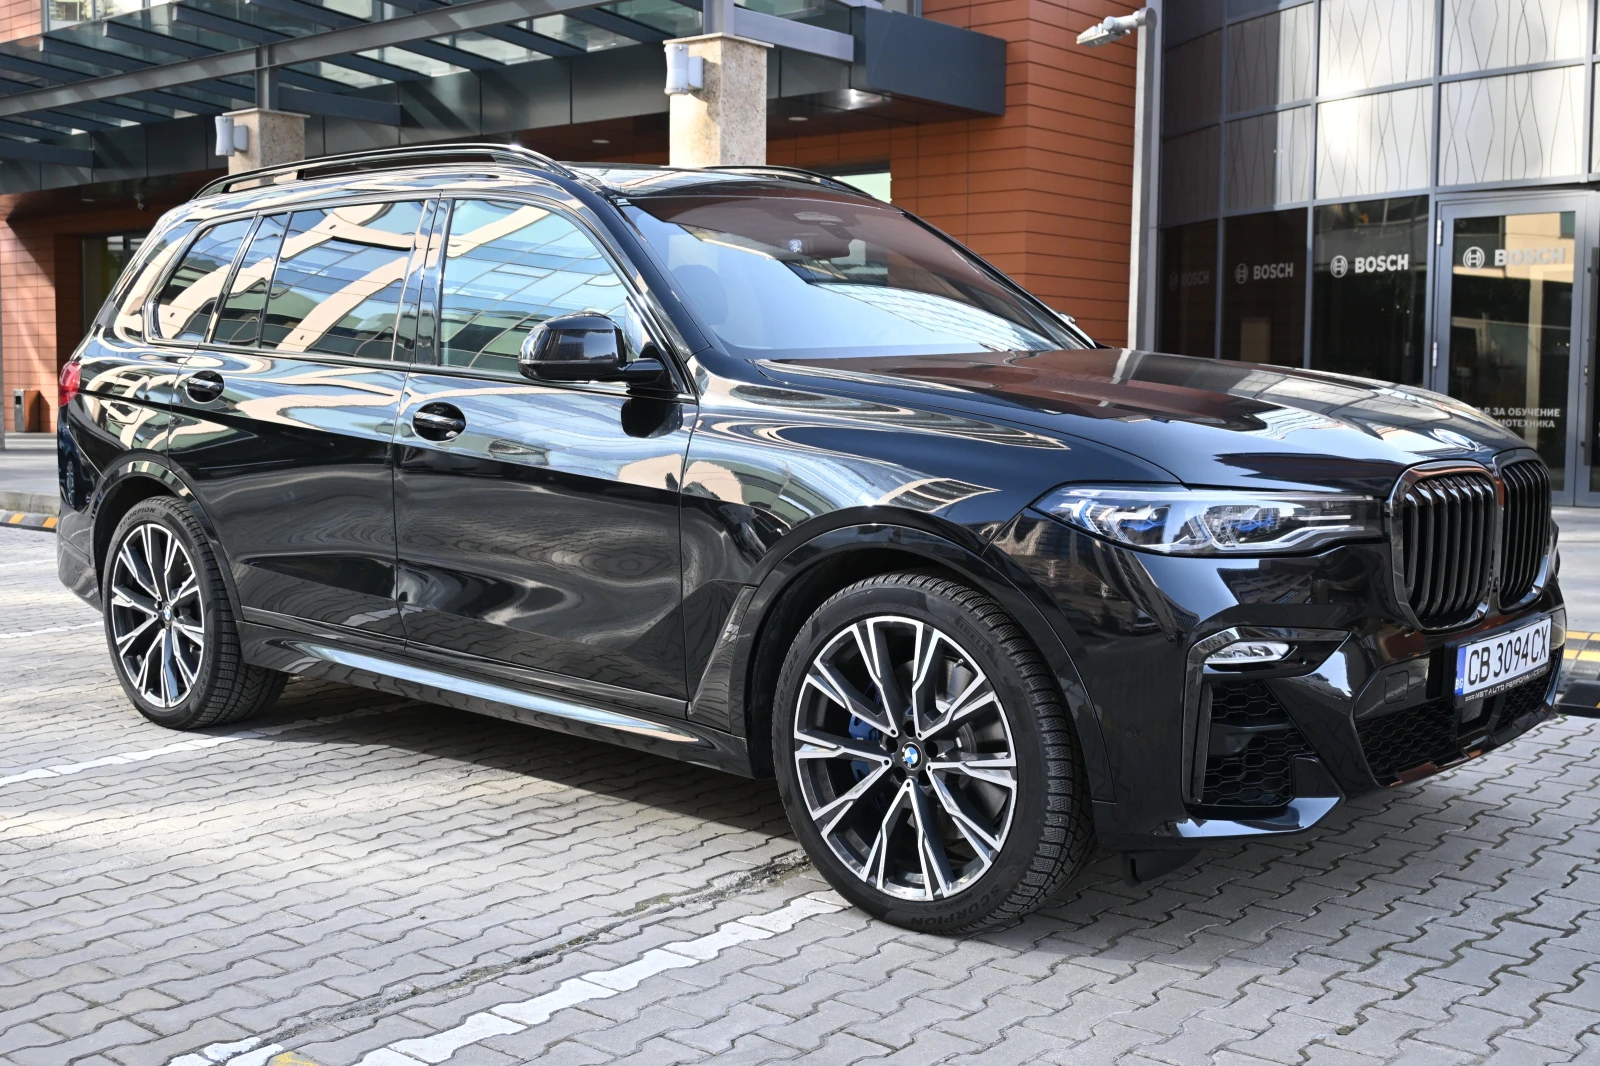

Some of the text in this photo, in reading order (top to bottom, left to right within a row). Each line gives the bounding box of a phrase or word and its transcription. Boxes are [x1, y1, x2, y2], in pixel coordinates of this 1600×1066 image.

[1354, 254, 1409, 273] BOSCH
[1494, 247, 1565, 267] BOSCH
[1181, 271, 1209, 287] BOSCH
[1253, 263, 1294, 280] BOSCH
[1493, 407, 1506, 416] ЗА
[1508, 407, 1561, 417] ОБУЧЕНИЕ
[1468, 624, 1549, 686] CB 3094 CX
